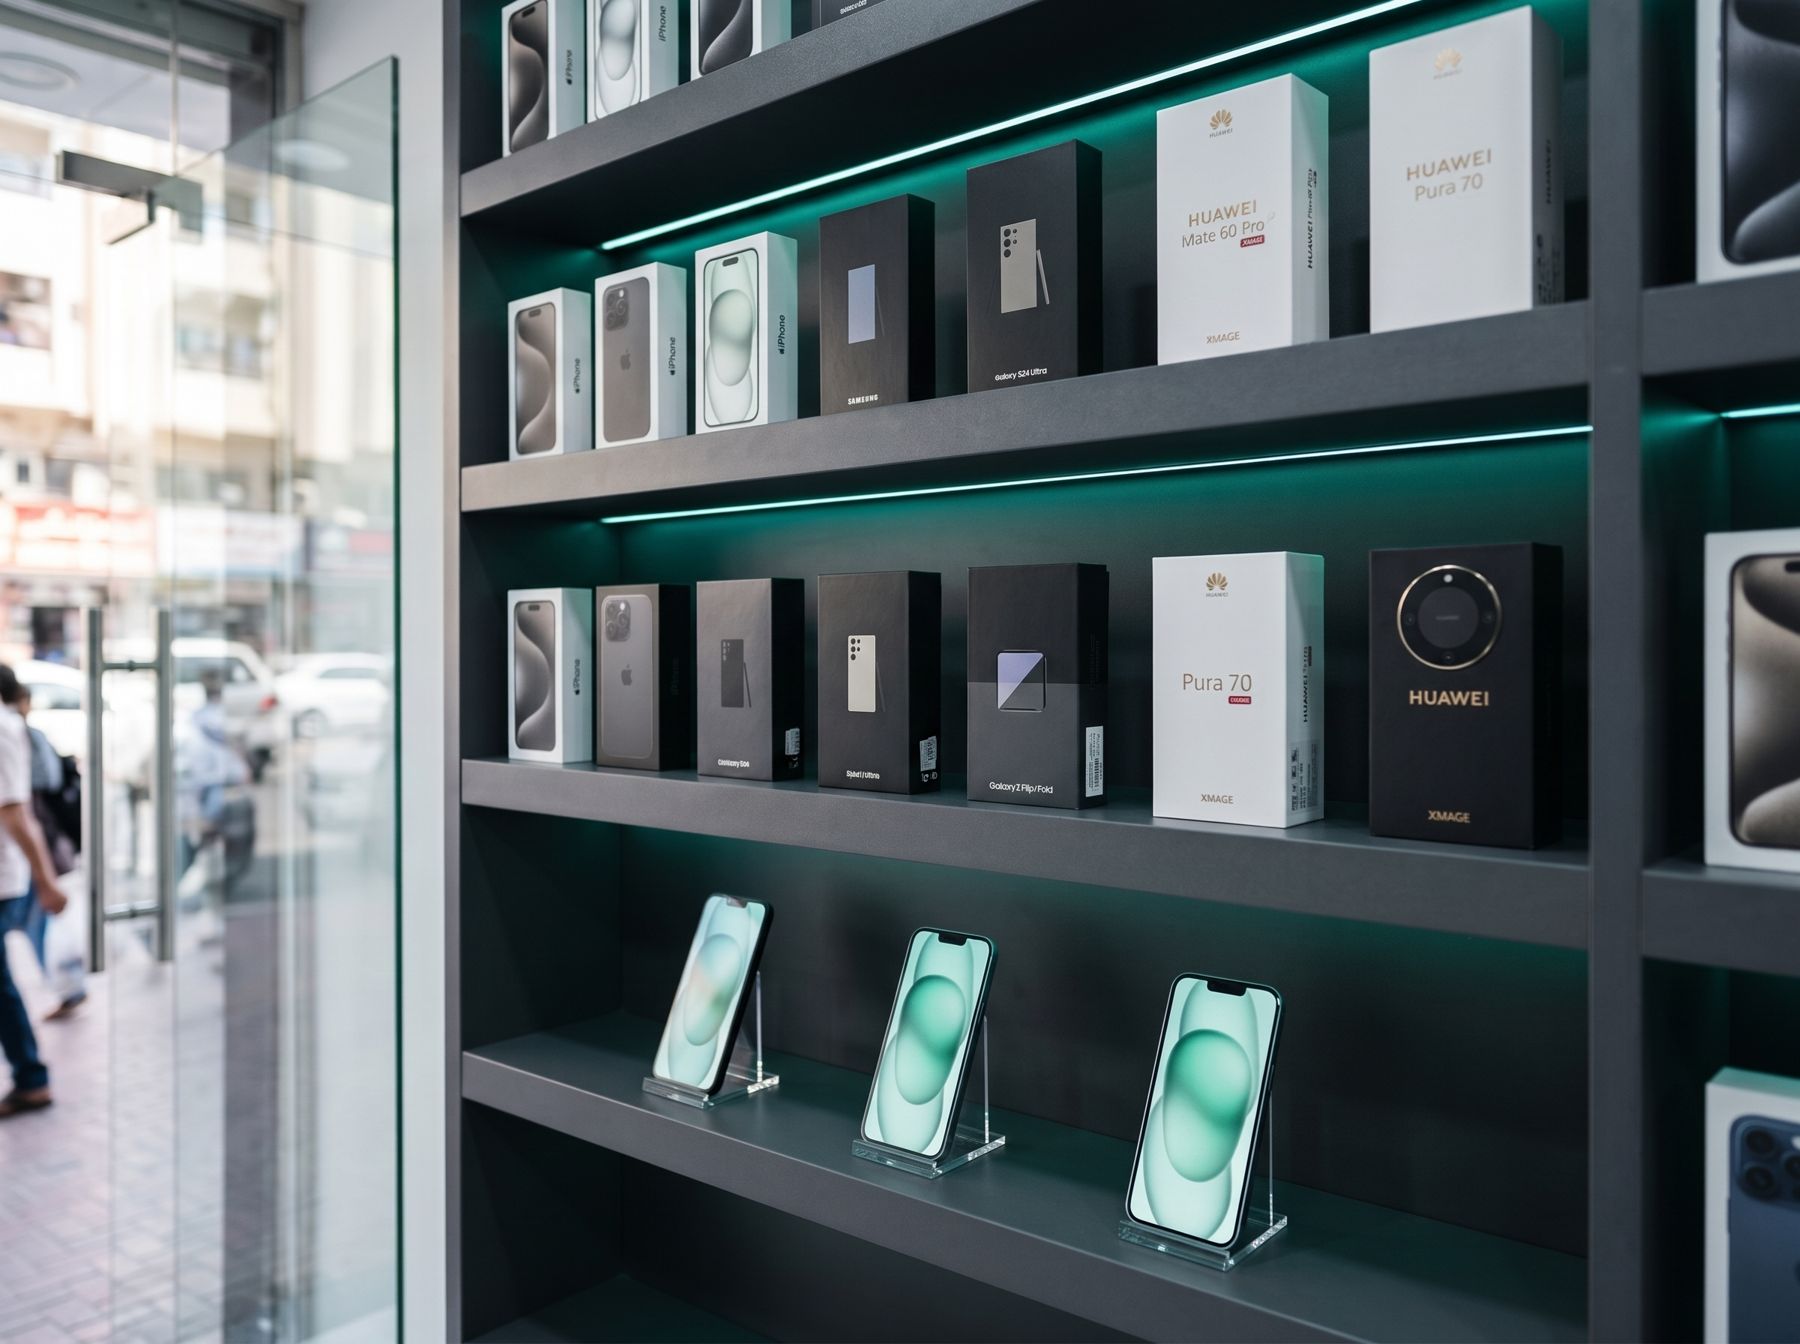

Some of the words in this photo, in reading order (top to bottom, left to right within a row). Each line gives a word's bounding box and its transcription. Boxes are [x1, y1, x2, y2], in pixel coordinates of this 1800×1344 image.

[1407, 149, 1492, 181] HUAWEI
[1415, 182, 1456, 201] Pura
[1461, 172, 1483, 192] 70
[1188, 199, 1257, 228] HUAWEI
[1182, 231, 1216, 248] Mate
[1220, 224, 1237, 240] 60
[1242, 221, 1265, 235] Pro
[777, 314, 786, 348] iPhone
[1206, 331, 1240, 344] XMAGE
[668, 337, 676, 369] iPhone
[1017, 369, 1030, 378] S24
[1183, 673, 1223, 691] Pura
[1228, 674, 1252, 692] 70
[1409, 690, 1490, 706] HUAWEI
[989, 781, 1016, 793] Galaxy
[1015, 783, 1021, 792] Z
[1200, 794, 1234, 804] XMAGE
[1428, 810, 1471, 824] XMAGE
